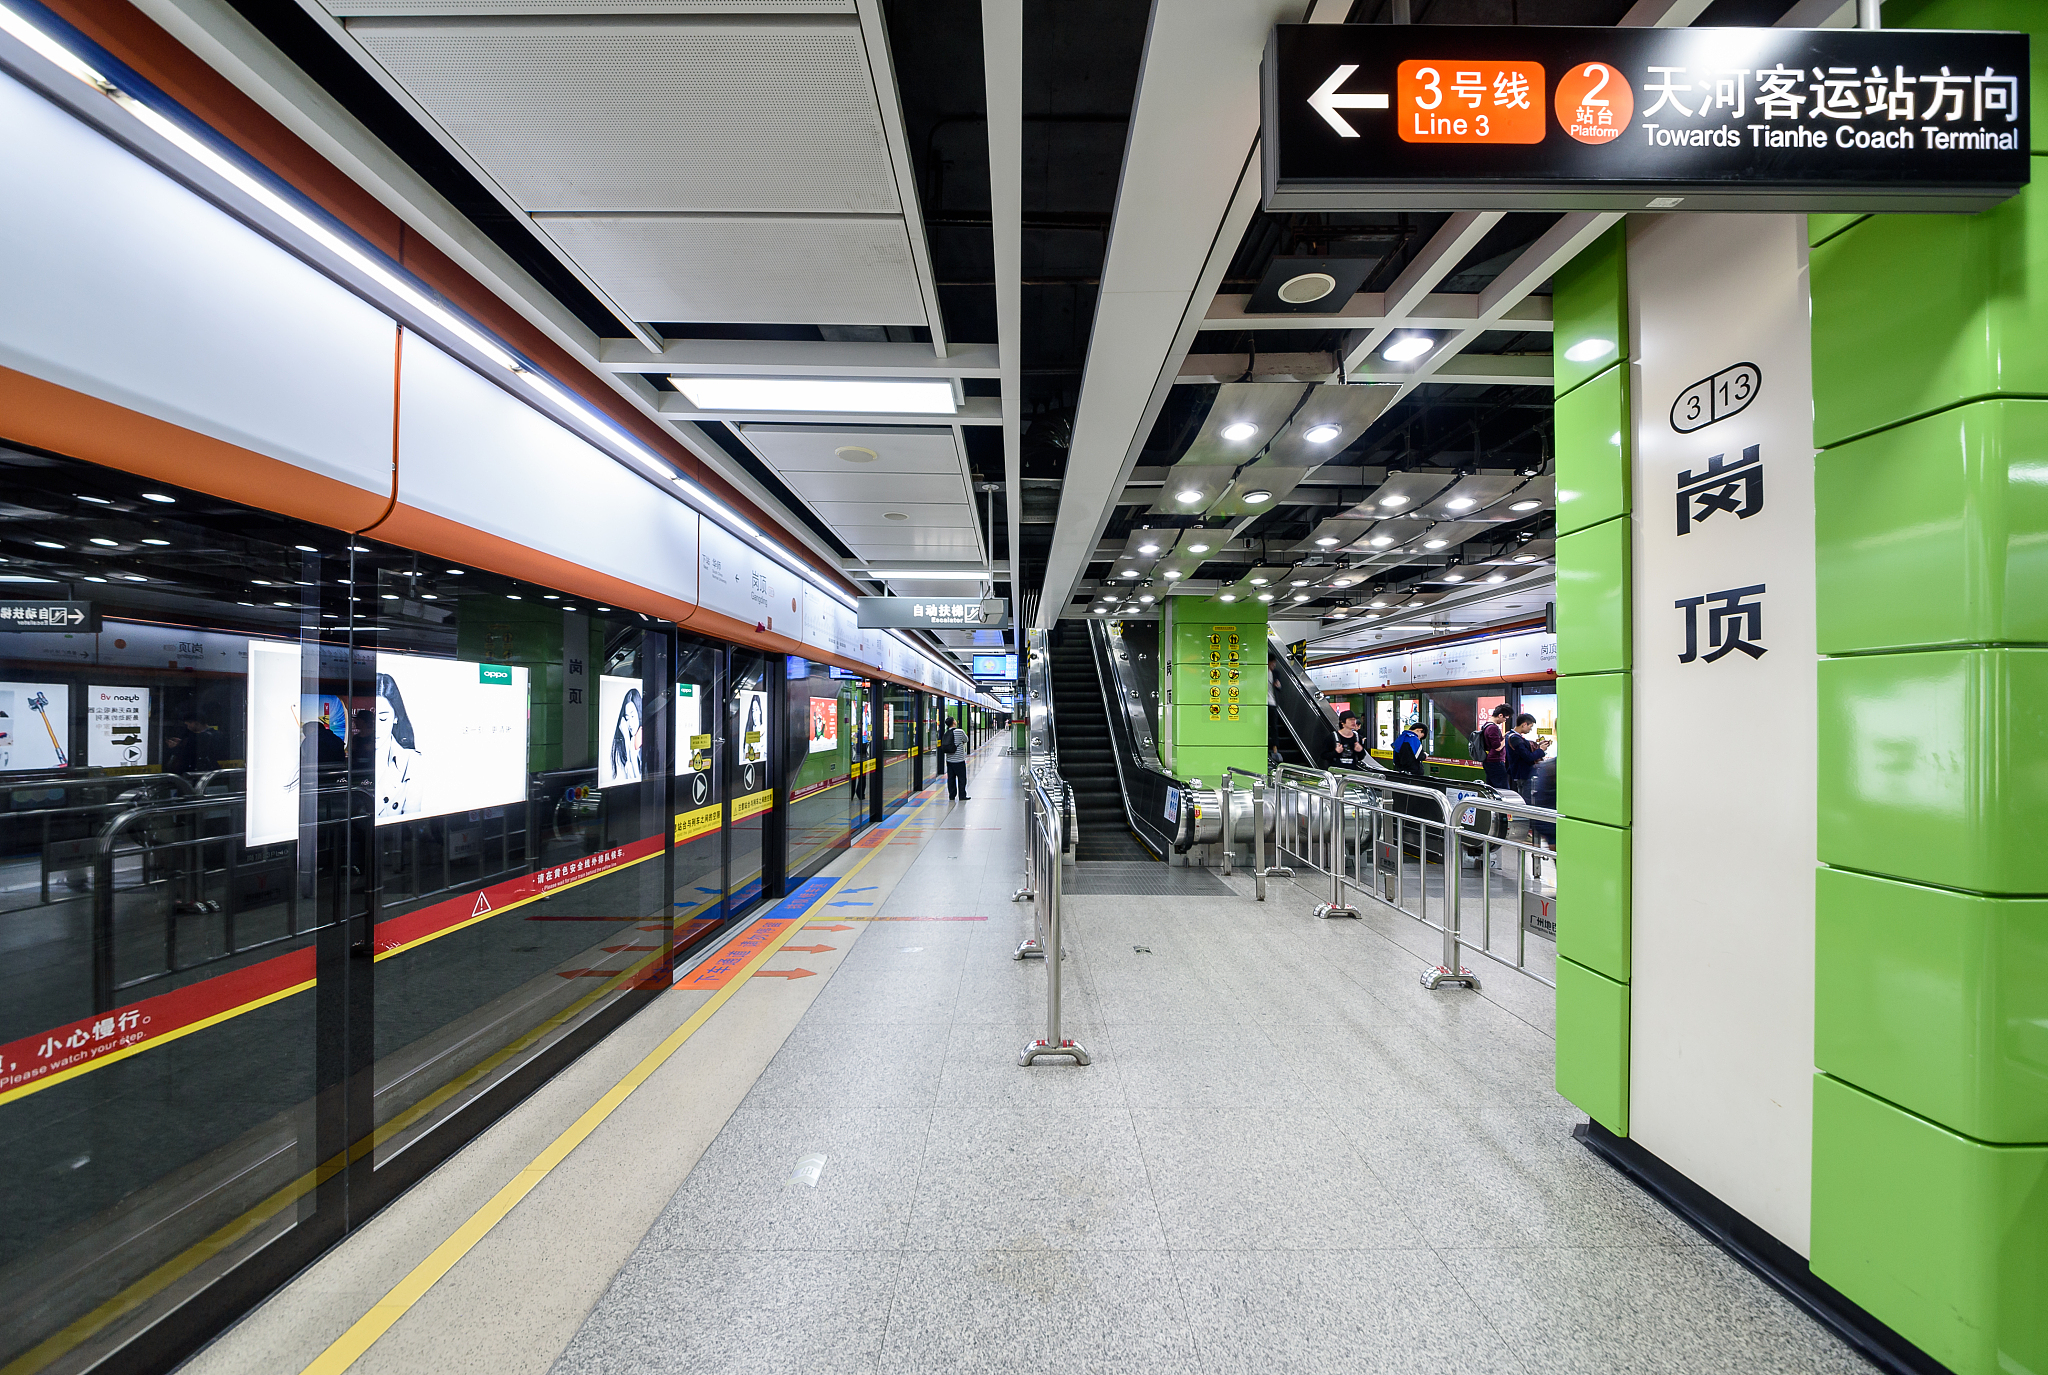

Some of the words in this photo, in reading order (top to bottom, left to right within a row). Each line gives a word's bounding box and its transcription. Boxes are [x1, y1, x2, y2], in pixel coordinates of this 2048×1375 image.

[1415, 66, 1530, 110] 3号线
[1581, 64, 1610, 107] 2
[1642, 63, 2018, 122] 天河客运站方向
[1414, 112, 1468, 135] Line
[1475, 114, 1490, 137] 3
[1570, 124, 1619, 138] Platform
[1575, 106, 1613, 126] 站台
[1642, 123, 1741, 148] Towards
[1747, 124, 1828, 149] Tianhe
[1835, 125, 1914, 150] Coach
[1922, 126, 2018, 151] Terminal
[1686, 395, 1701, 421] 3
[1718, 373, 1751, 407] 13
[1675, 443, 1768, 664] 岗顶
[913, 603, 964, 617] 自动扶梯
[50, 1051, 88, 1070] watch
[91, 1039, 118, 1057] your
